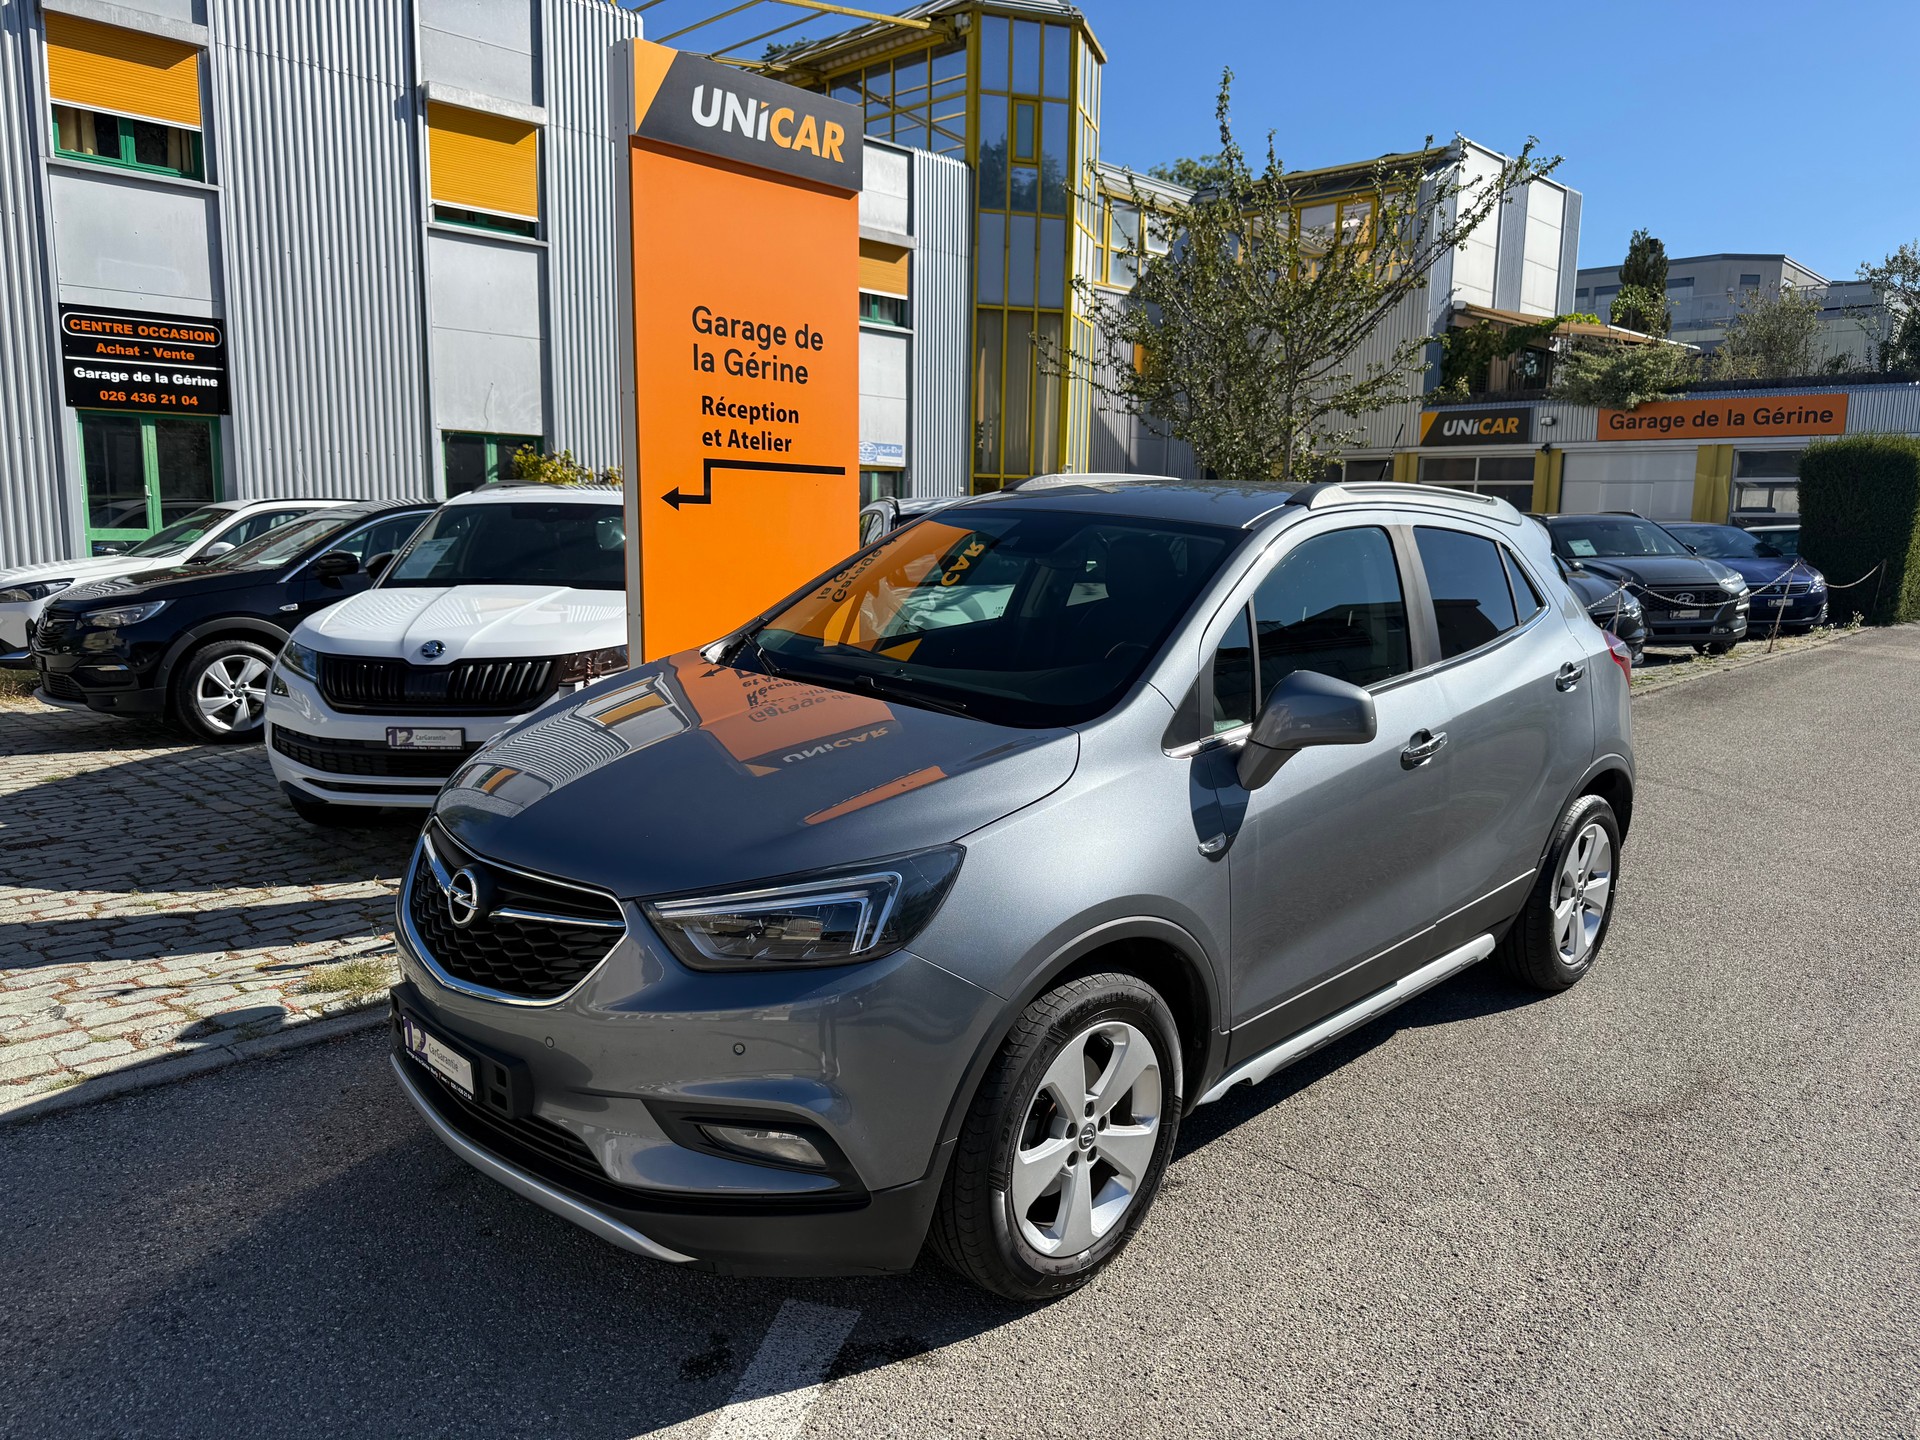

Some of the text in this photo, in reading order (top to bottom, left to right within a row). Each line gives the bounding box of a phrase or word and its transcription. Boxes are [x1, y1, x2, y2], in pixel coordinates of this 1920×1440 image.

[691, 84, 845, 163] UNiCAR
[69, 319, 216, 343] CENTRE OCCASION
[692, 305, 824, 351] Garage de
[95, 342, 140, 356] Achat
[152, 347, 195, 360] Vente
[693, 343, 808, 384] la Gérine
[73, 367, 218, 387] Garage de la Gérine
[100, 390, 199, 406] 026 436 21 04
[701, 395, 799, 425] Réception
[1442, 417, 1519, 436] UNiCAR
[1608, 406, 1834, 433] Garage de la Gérine
[702, 429, 792, 452] et Atelier
[428, 1043, 459, 1072] CarGarantie
